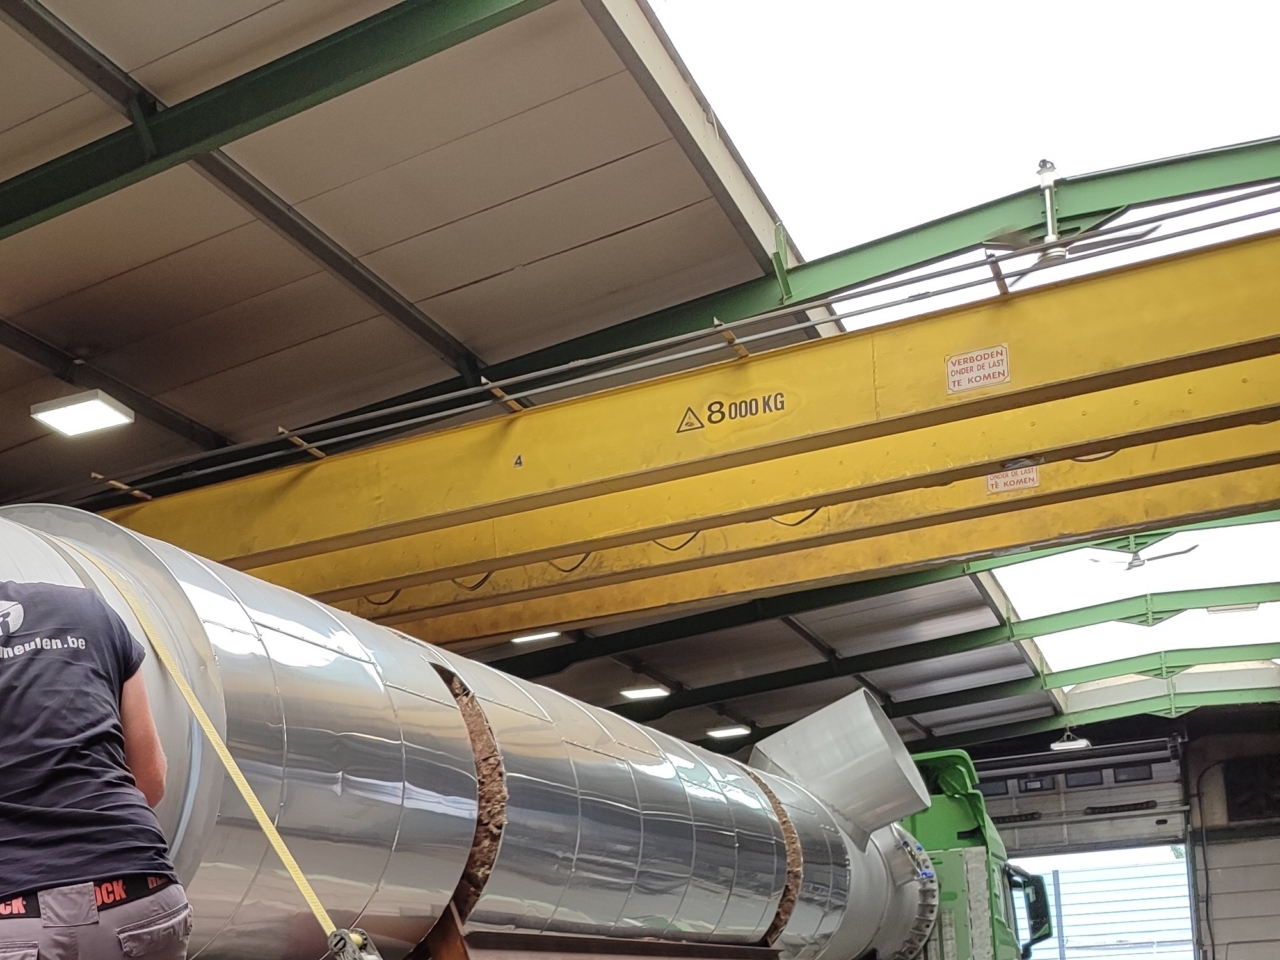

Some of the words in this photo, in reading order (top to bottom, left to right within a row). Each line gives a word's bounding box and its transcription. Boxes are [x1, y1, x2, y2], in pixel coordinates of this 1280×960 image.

[951, 349, 1004, 367] VERBODEN
[951, 365, 974, 377] ONDER
[977, 362, 985, 372] DE
[989, 359, 1004, 369] LAST
[952, 379, 962, 388] TE
[967, 370, 1006, 384] KOMEN
[707, 398, 759, 425] 8000
[762, 392, 785, 414] KG
[514, 454, 523, 467] 4
[1021, 467, 1034, 476] LAST
[1004, 477, 1035, 487] KOMEN
